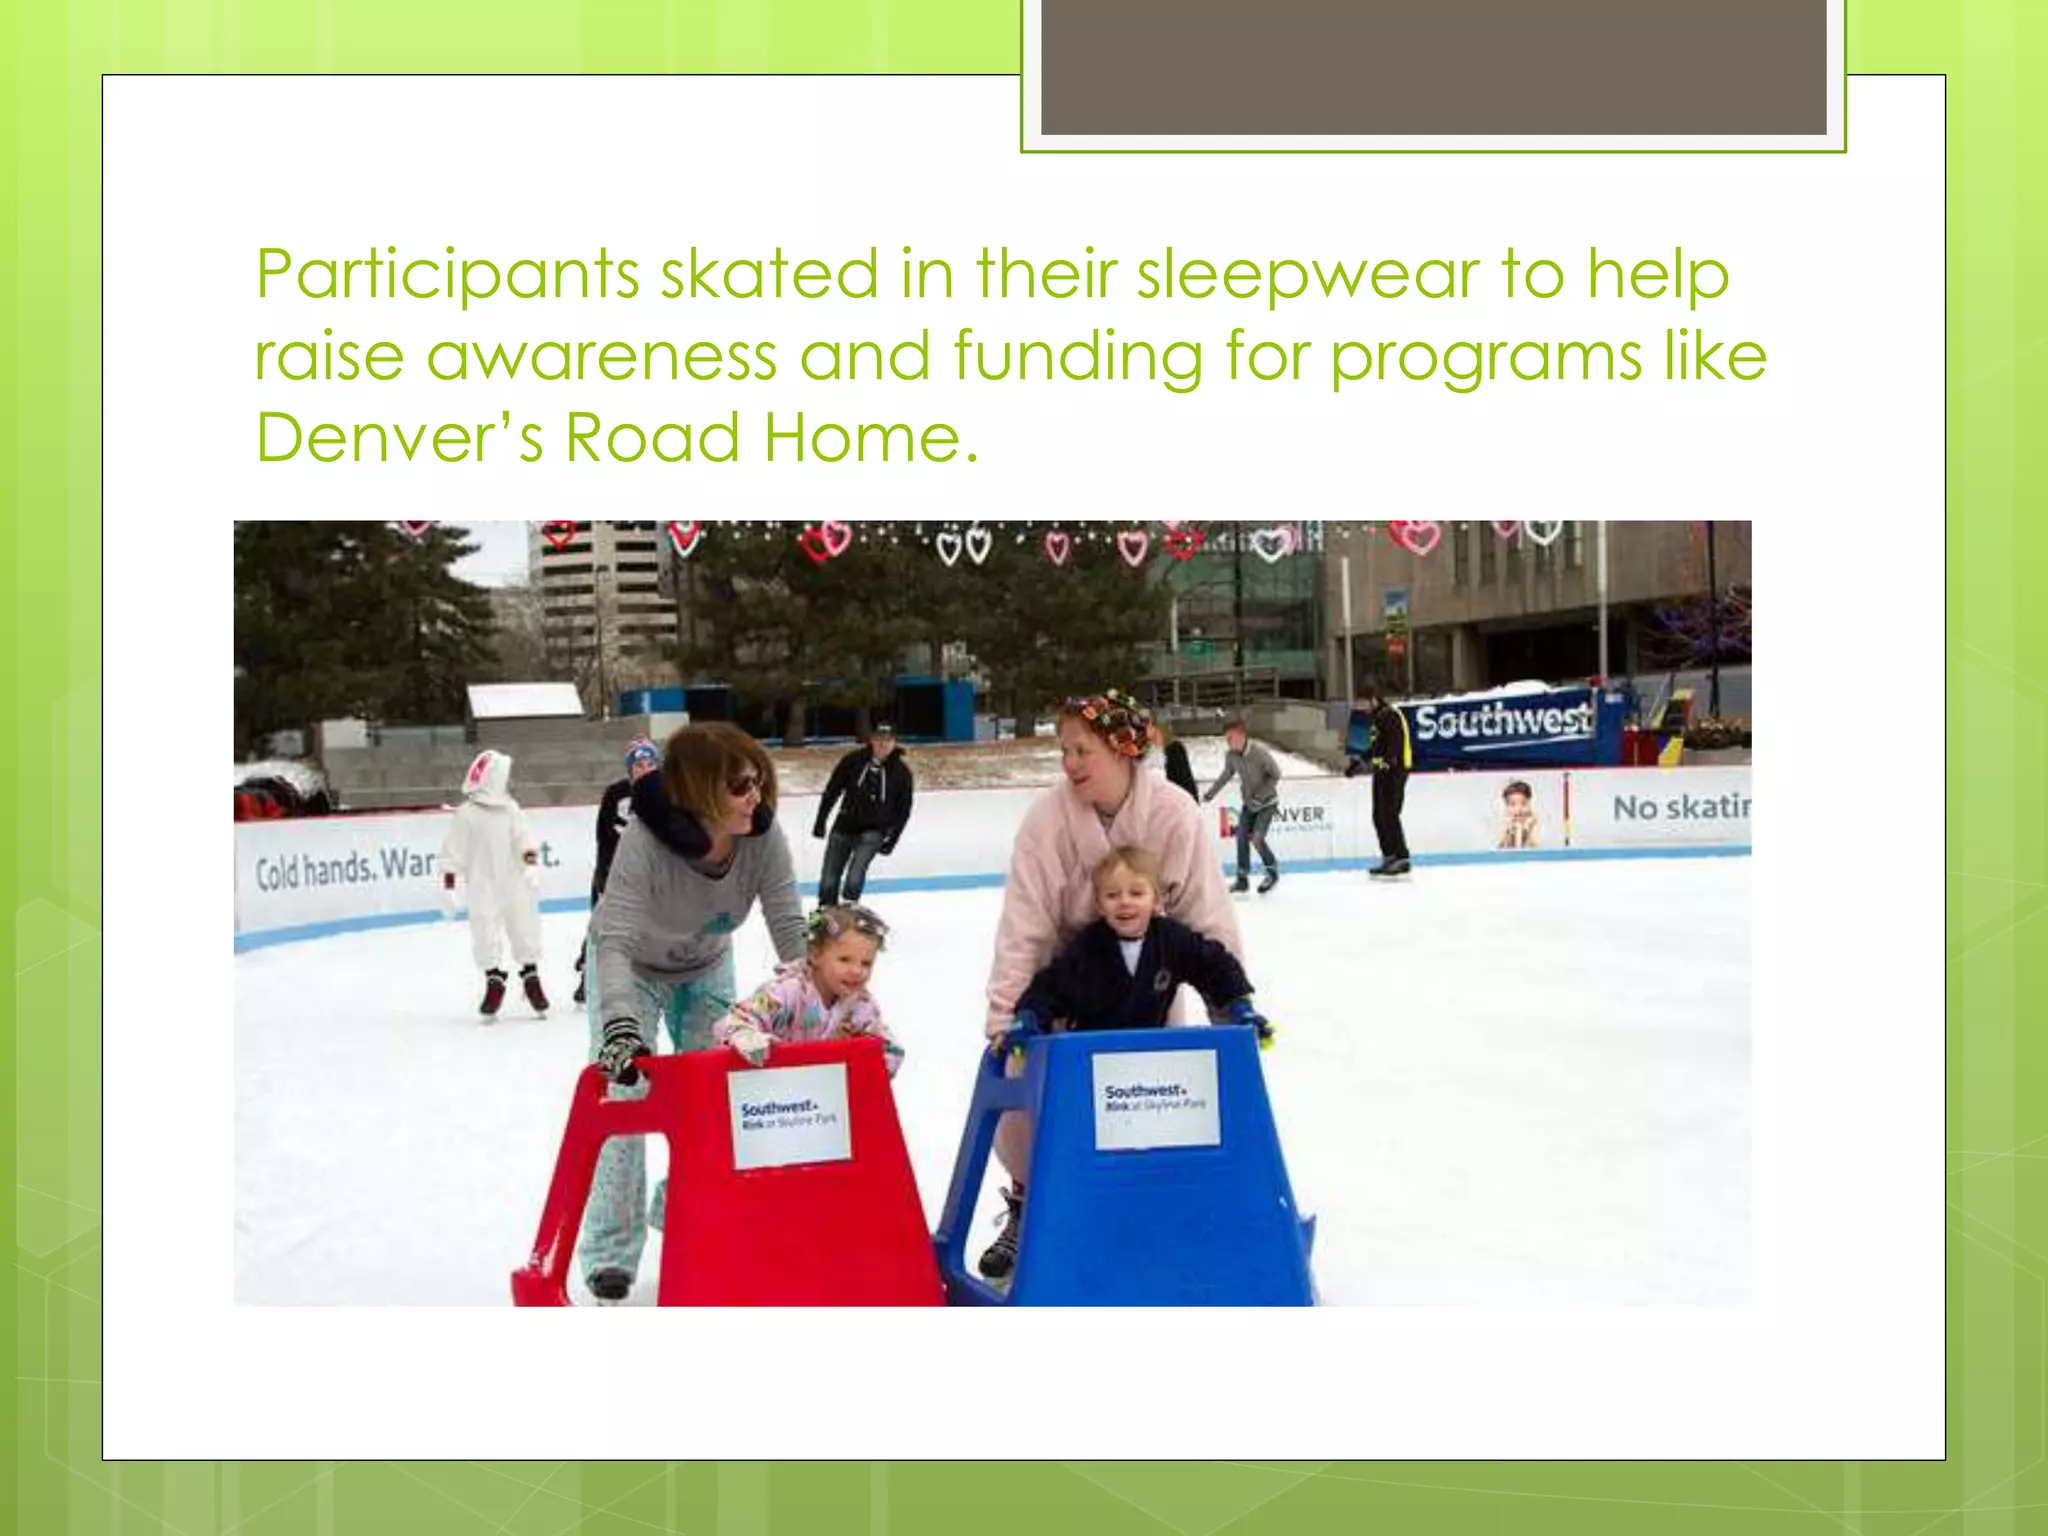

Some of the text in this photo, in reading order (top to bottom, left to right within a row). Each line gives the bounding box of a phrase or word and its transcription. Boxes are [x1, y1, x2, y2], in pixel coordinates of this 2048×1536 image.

[1415, 701, 1594, 740] Southwest
[1614, 795, 1658, 820] No
[256, 848, 438, 892] Cold hands. War
[1105, 1084, 1180, 1100] Southwest
[742, 1099, 811, 1117] Southwest
